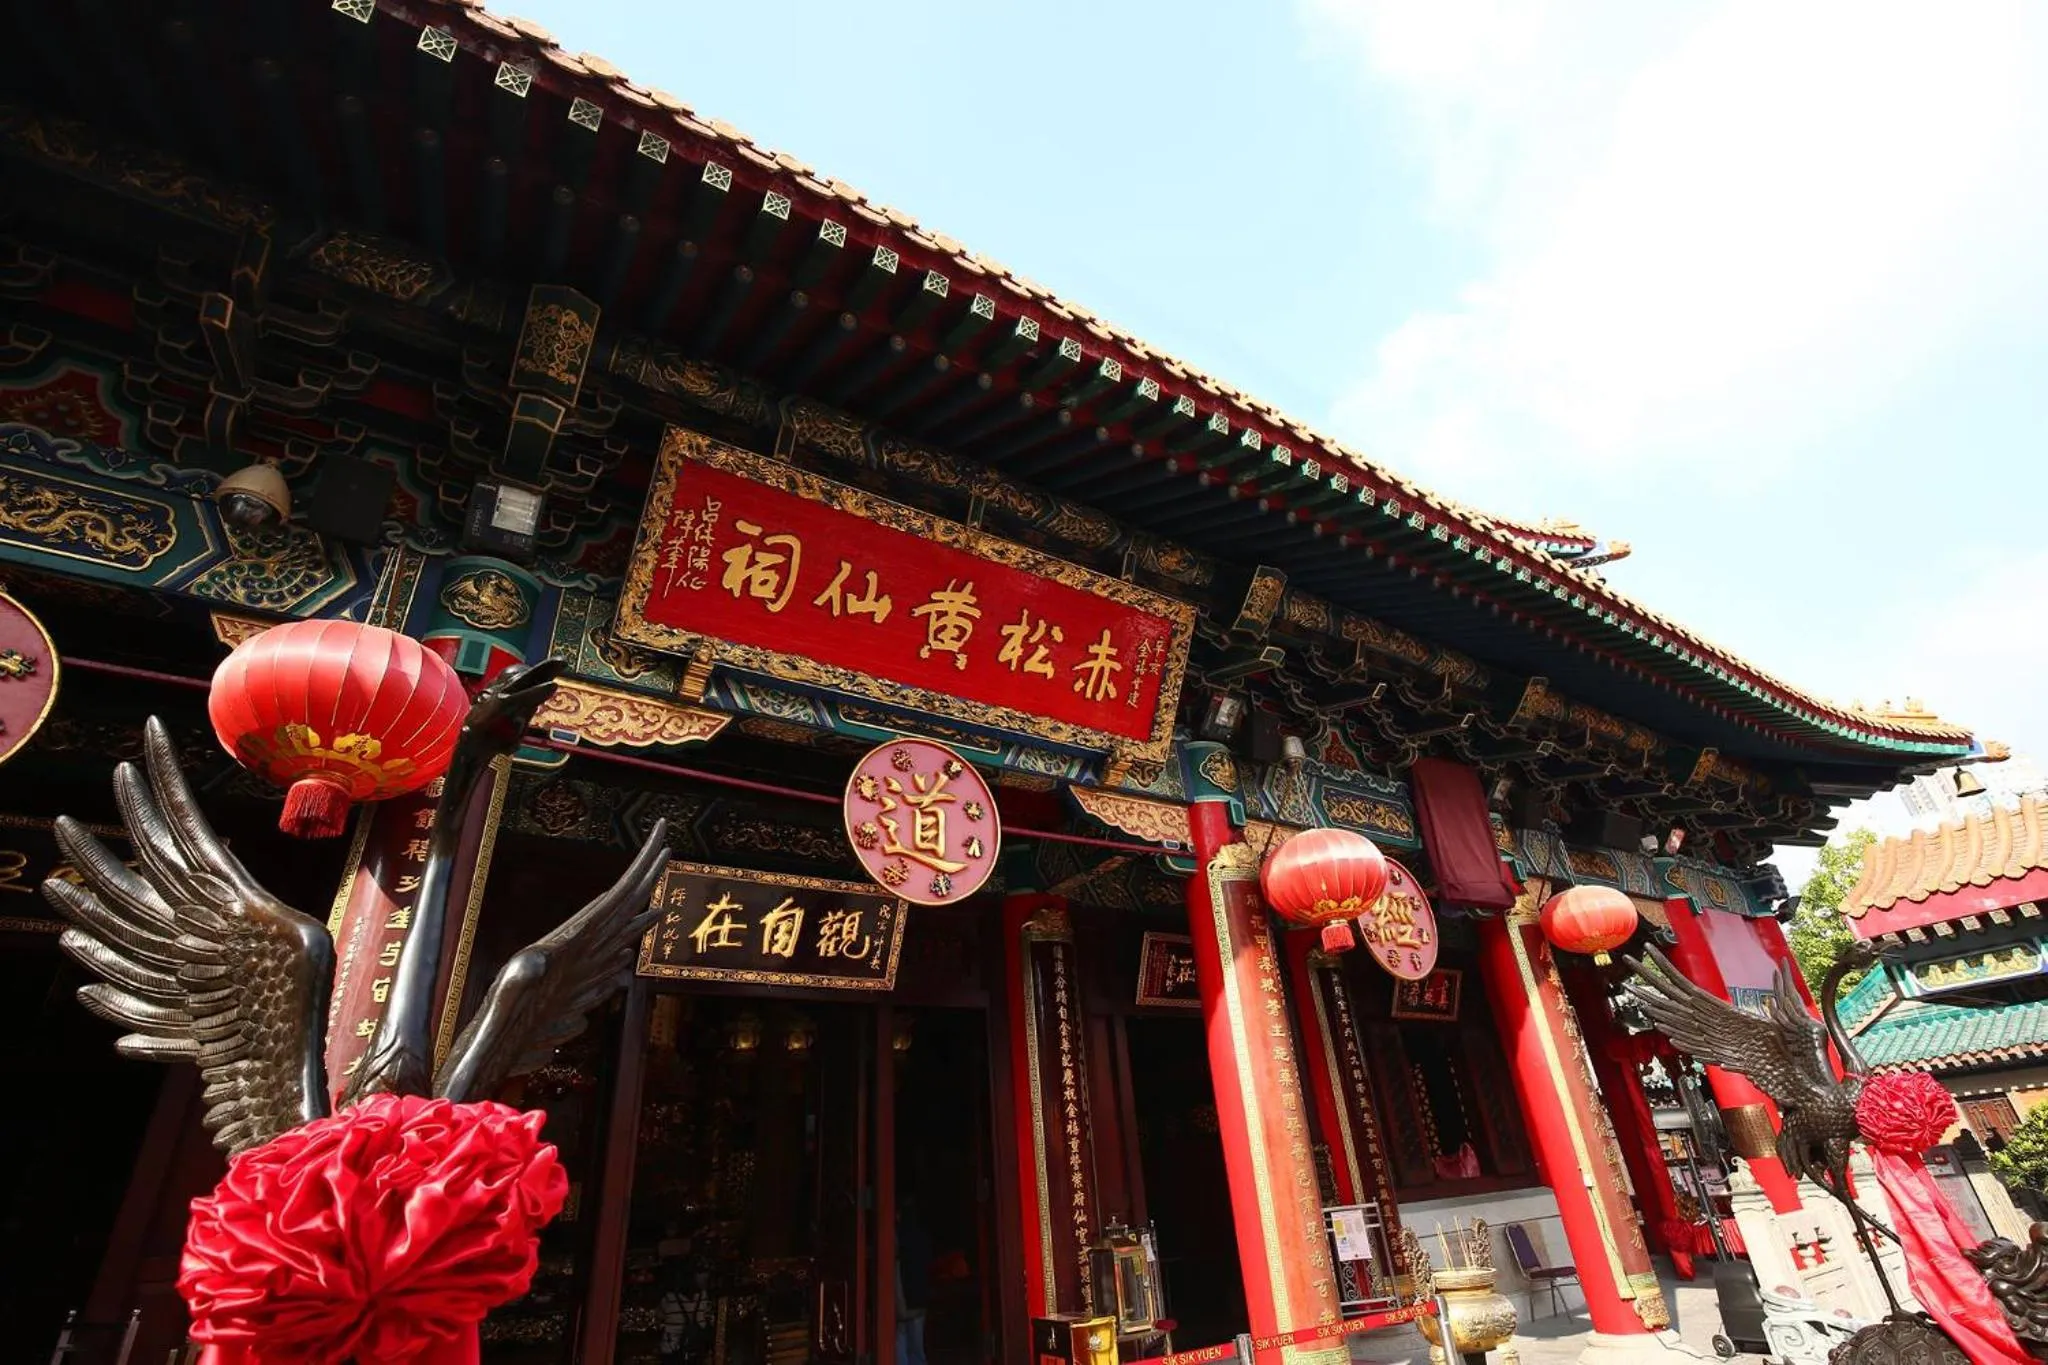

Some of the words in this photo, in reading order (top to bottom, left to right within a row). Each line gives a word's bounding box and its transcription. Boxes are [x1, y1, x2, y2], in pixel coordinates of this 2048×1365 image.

[877, 771, 968, 874] 道
[689, 891, 870, 960] 觀自在
[1317, 1327, 1330, 1338] SIK
[1331, 1324, 1345, 1335] SIK
[1256, 1339, 1270, 1351] SIK
[1272, 1333, 1294, 1348] YUEN
[1179, 1353, 1195, 1365] SIK
[1195, 1346, 1222, 1361] YUEN
